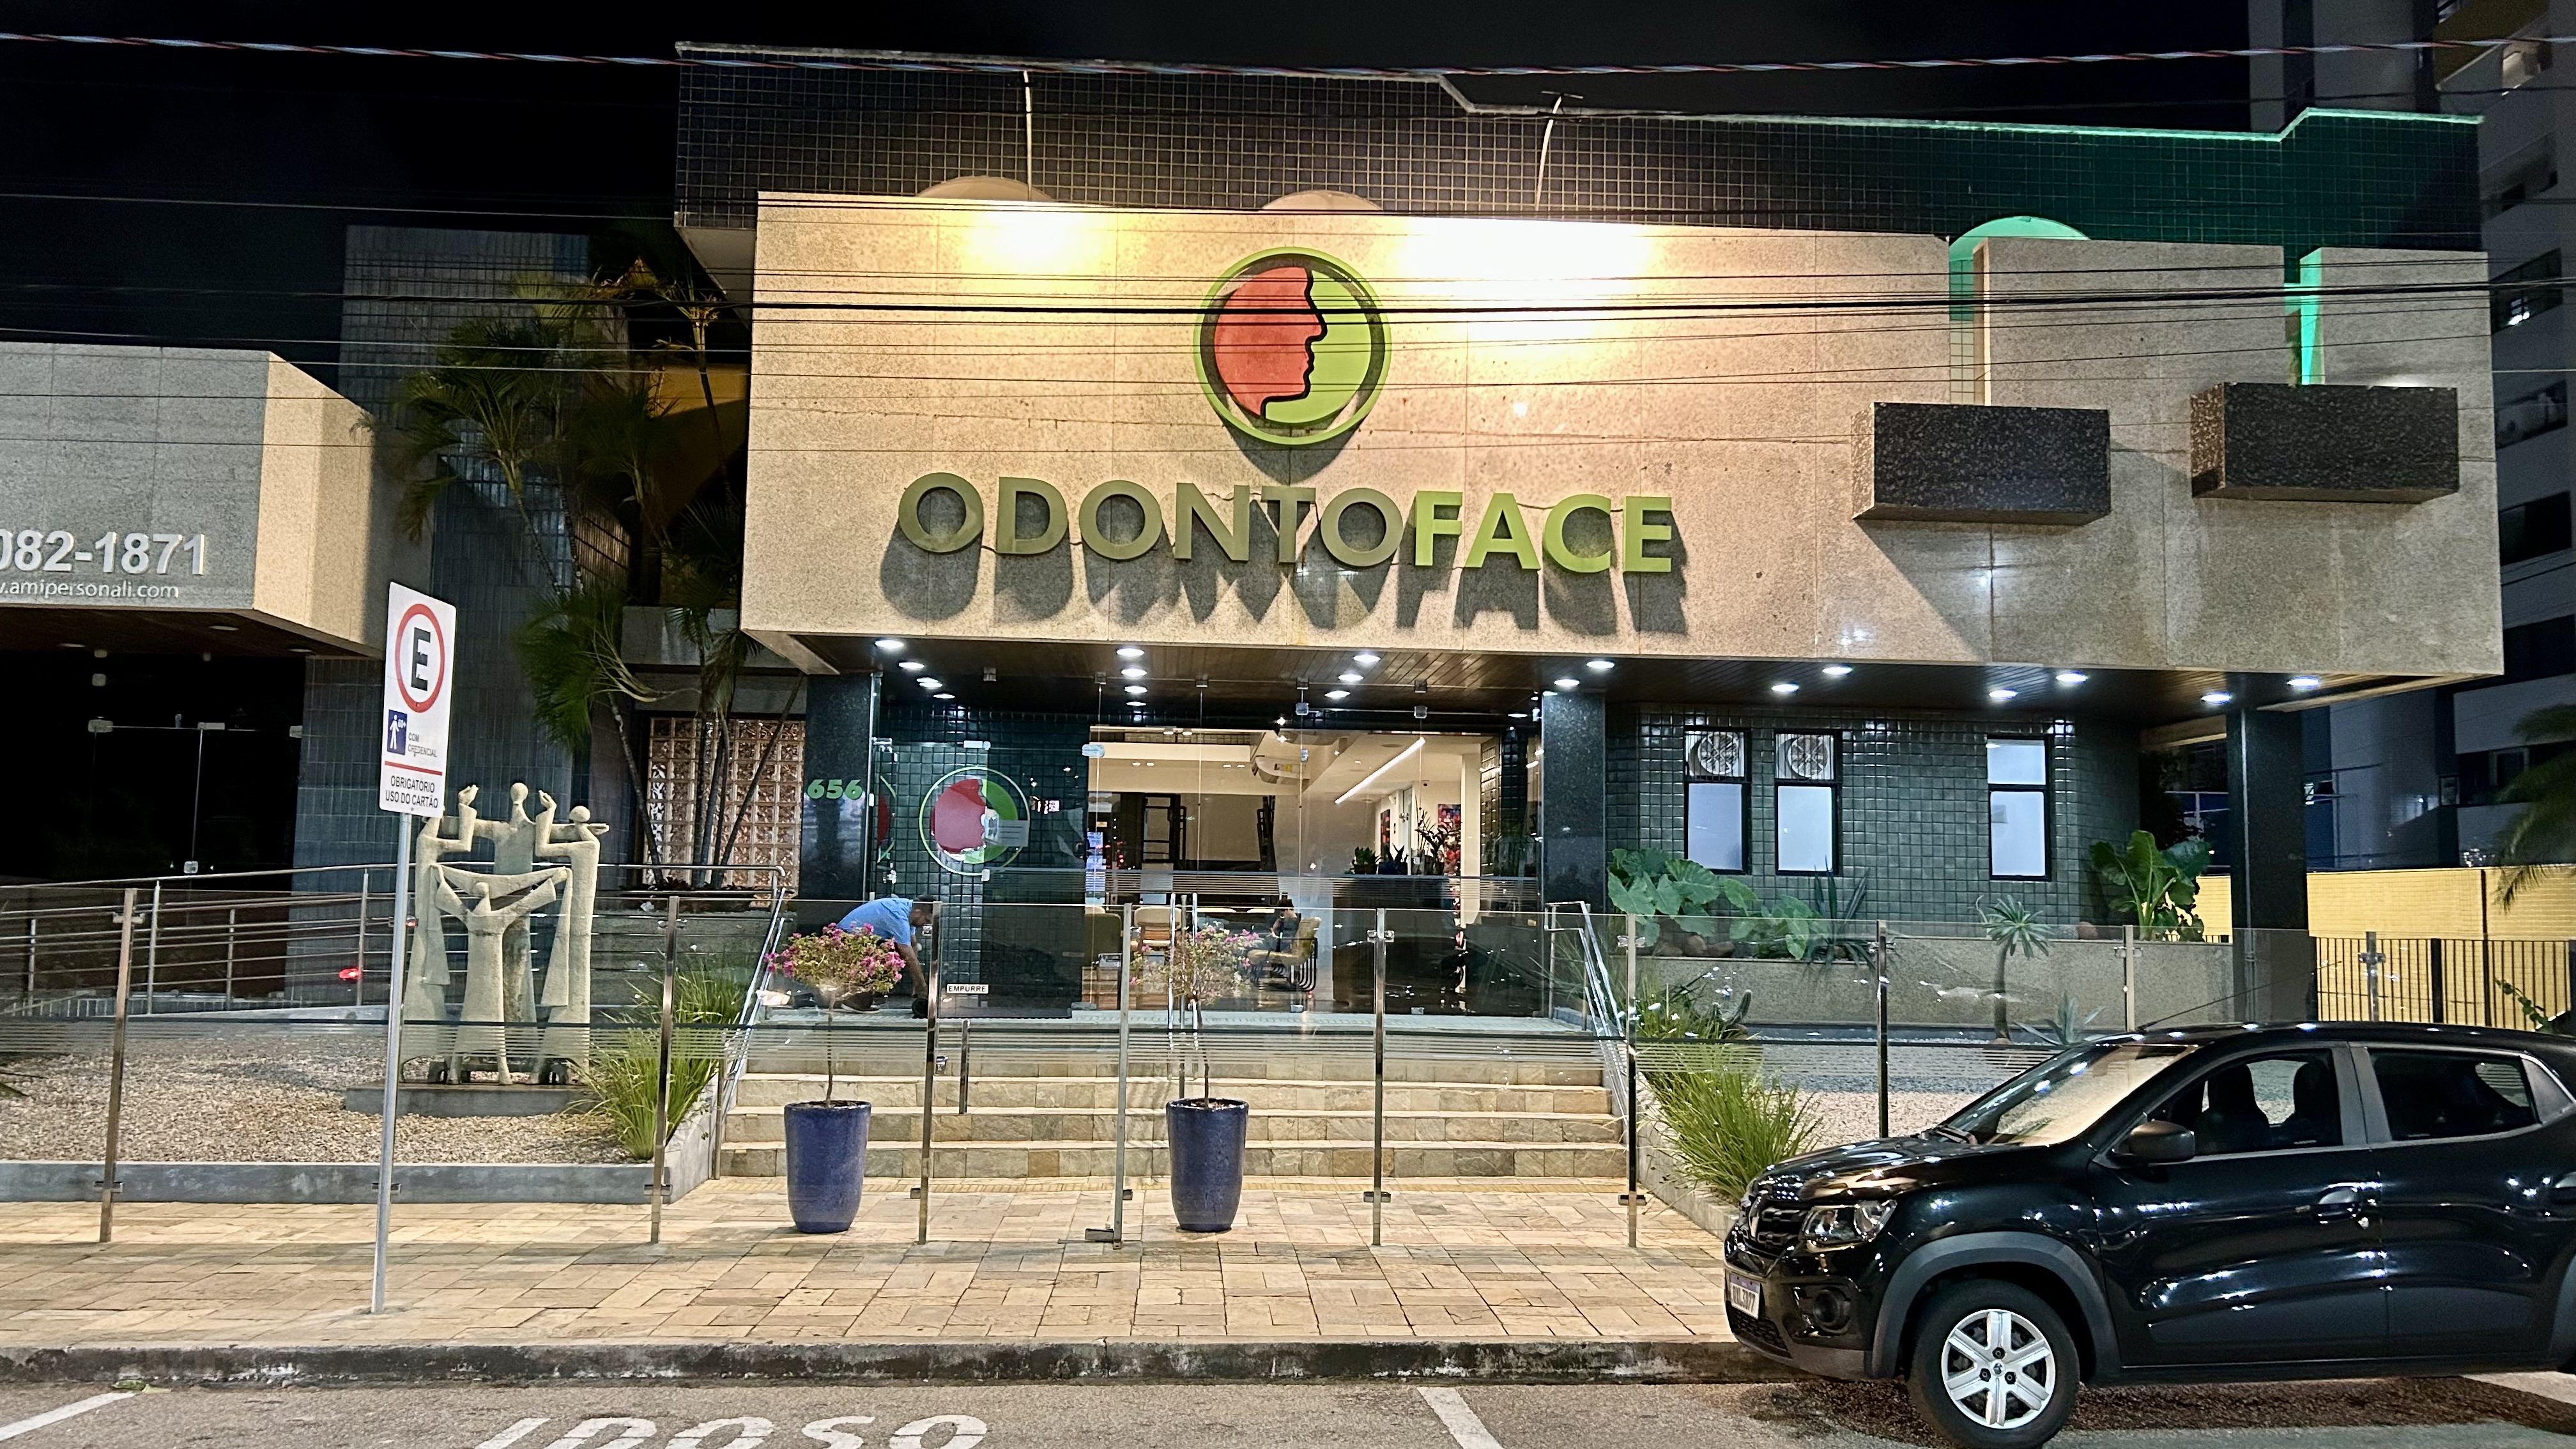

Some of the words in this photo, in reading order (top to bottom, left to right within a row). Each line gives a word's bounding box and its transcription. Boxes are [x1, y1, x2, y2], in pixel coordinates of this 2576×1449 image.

[898, 472, 1672, 573] ODONTOFACE
[411, 627, 431, 691] E
[408, 732, 420, 742] COM
[408, 744, 437, 757] CREDENCIAL
[391, 775, 435, 793] OBRIGATÓRIO
[808, 779, 862, 800] 656
[385, 790, 399, 802] USO
[401, 792, 410, 804] DO
[411, 794, 438, 808] CARTÃO
